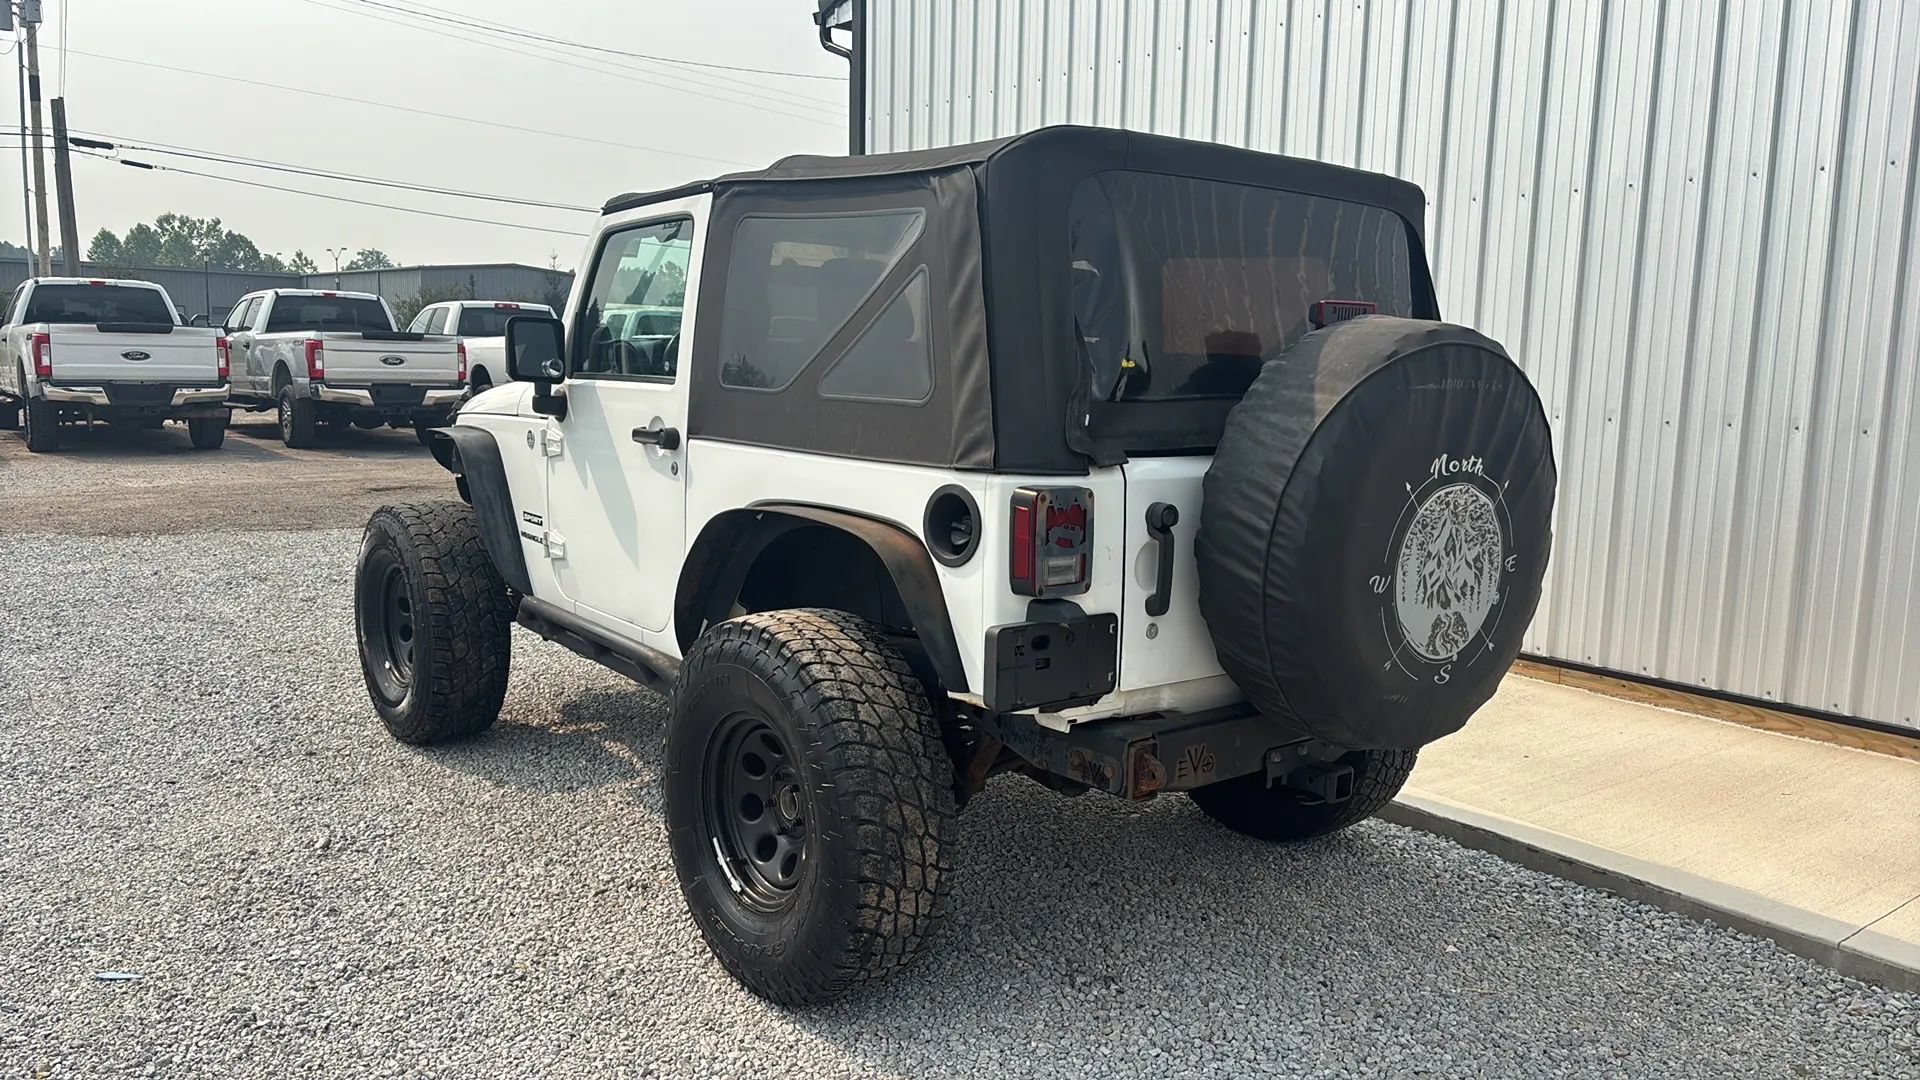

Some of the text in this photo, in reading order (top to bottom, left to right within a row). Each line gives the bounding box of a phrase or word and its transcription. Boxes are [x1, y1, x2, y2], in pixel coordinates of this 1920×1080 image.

[1430, 453, 1484, 479] North
[1505, 554, 1517, 572] E
[1369, 575, 1391, 593] W
[1434, 664, 1451, 684] S
